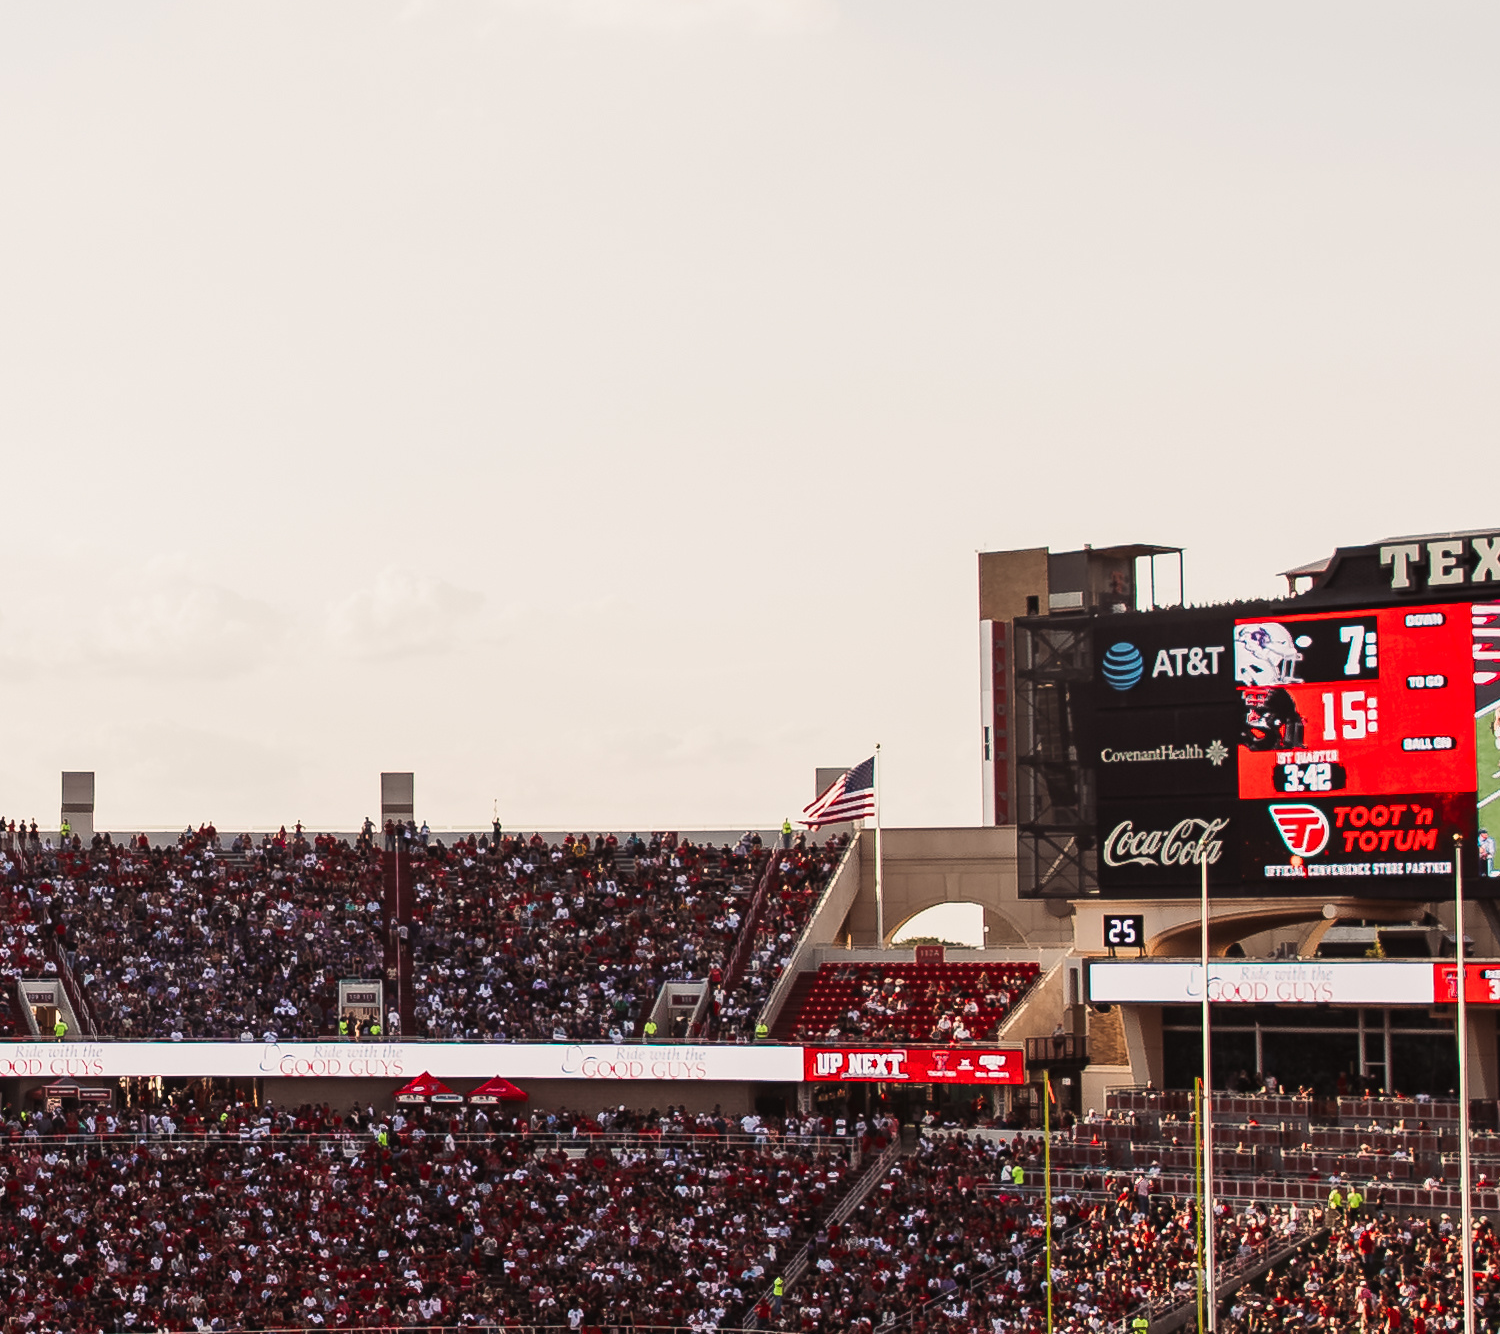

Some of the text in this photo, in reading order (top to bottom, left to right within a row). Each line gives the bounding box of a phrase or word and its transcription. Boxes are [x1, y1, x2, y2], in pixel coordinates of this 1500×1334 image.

[1340, 624, 1365, 675] 7
[1152, 646, 1225, 678] AT&T
[1321, 690, 1366, 741] 15
[1101, 744, 1204, 763] CovenantHealth
[1284, 763, 1332, 791] 3:42
[1333, 805, 1408, 827] TOOT
[1342, 829, 1438, 852] TOTUM
[1108, 919, 1136, 943] 25
[1239, 966, 1333, 981] Ride with the
[1207, 981, 1333, 1001] GOOD GUYS
[14, 1045, 104, 1058] Ride with the
[313, 1045, 404, 1059] Ride with the
[616, 1048, 706, 1061] Ride with the
[49, 1058, 104, 1076] GUYS
[279, 1058, 404, 1076] GOOD GUYS
[581, 1061, 707, 1078] GOOD GUYS
[816, 1053, 904, 1075] UP NEXT
